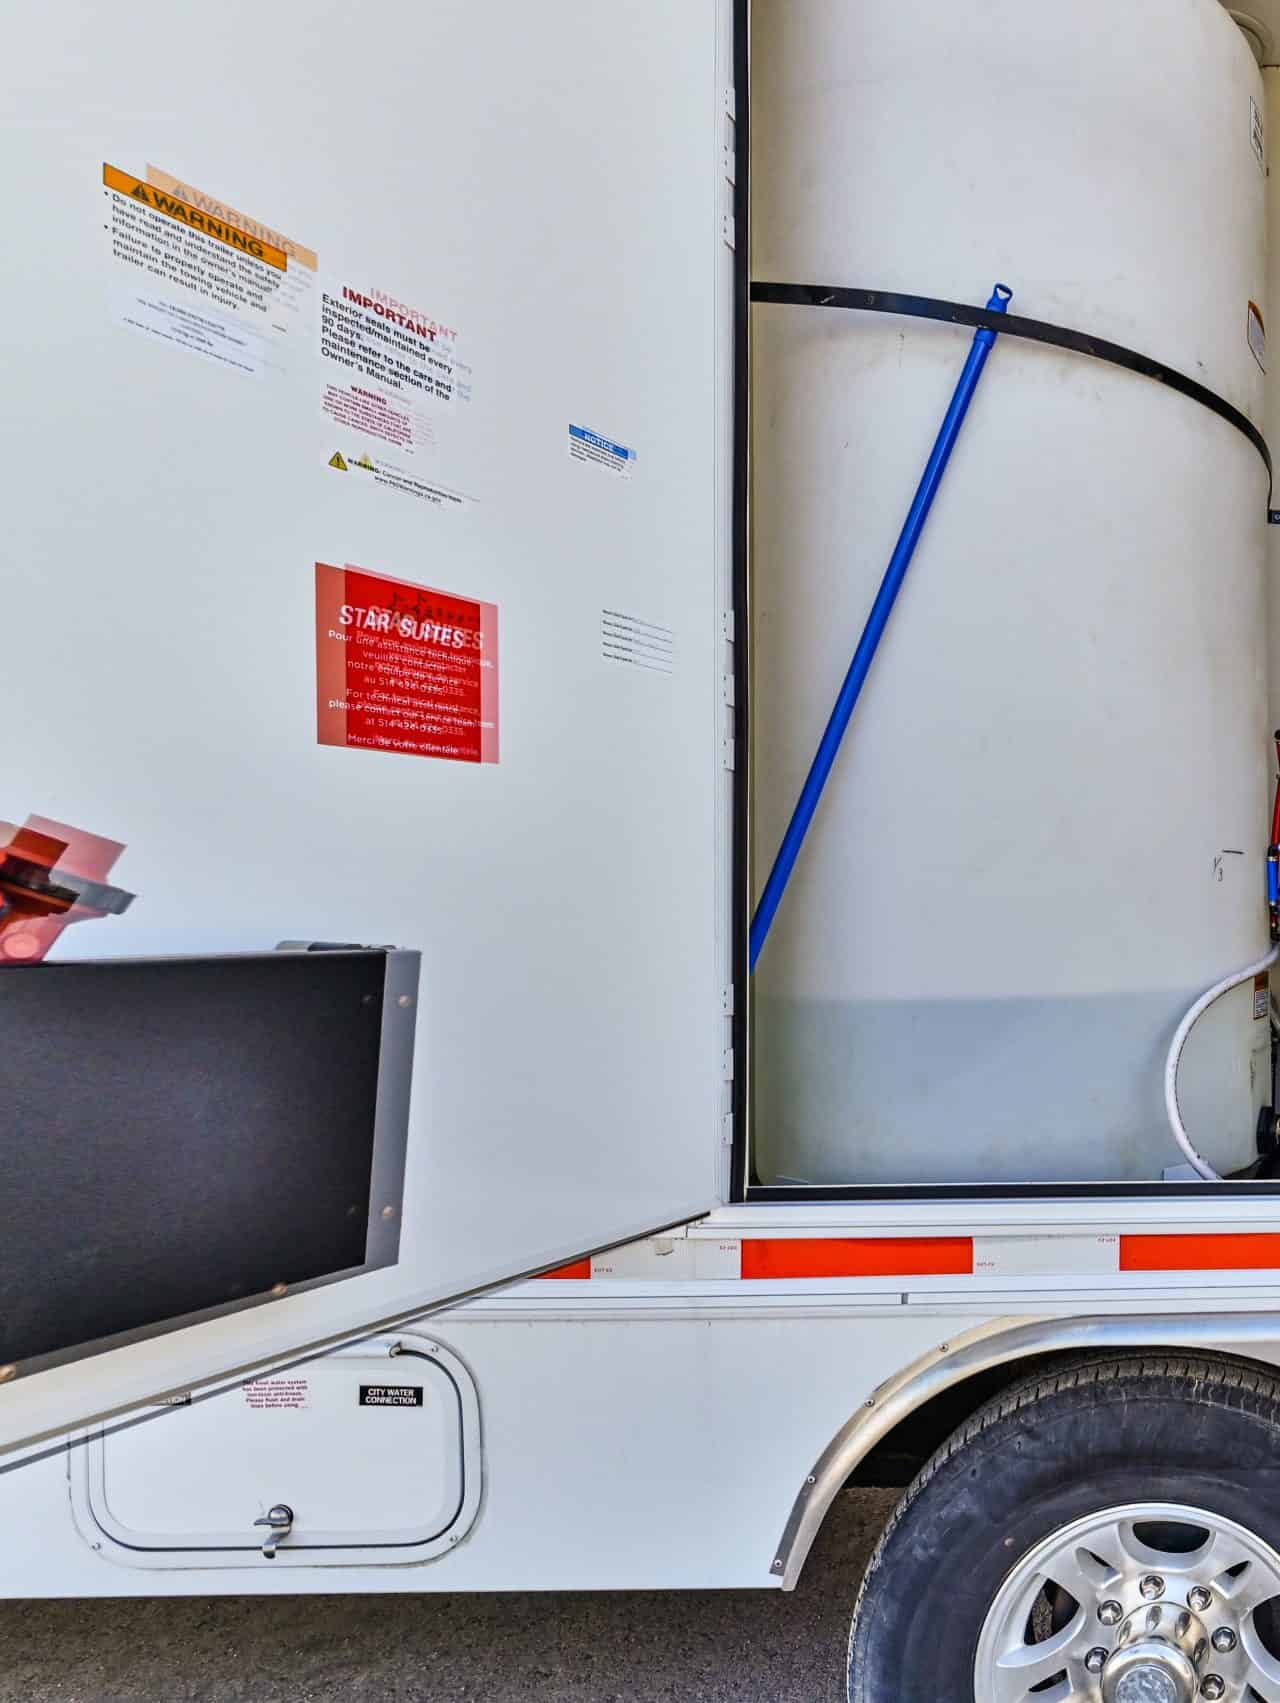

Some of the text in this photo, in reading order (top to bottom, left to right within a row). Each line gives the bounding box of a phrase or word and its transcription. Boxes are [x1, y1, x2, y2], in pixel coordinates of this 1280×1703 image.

[113, 194, 126, 205] Do
[130, 204, 145, 215] not
[149, 213, 186, 233] operate
[188, 230, 205, 243] this
[208, 240, 233, 256] trailer
[236, 255, 264, 271] unless
[113, 216, 169, 246] information
[172, 242, 181, 252] in
[183, 248, 198, 259] the
[113, 204, 280, 288] have read and understand the safety
[152, 191, 265, 258] WARNING
[112, 227, 262, 301] Failure to properly operate and
[113, 239, 266, 312] maintain the towing vehicle and
[113, 249, 240, 310] trailer can result in injury.
[322, 315, 334, 327] 90
[322, 294, 431, 352] Exterior seals must be
[322, 304, 452, 374] inspected/maintained every
[342, 286, 437, 342] IMPORTANT
[321, 347, 404, 390] Owner's Manual.
[321, 338, 450, 400] maintenance section of the
[322, 325, 452, 392] Please refer to the care and
[351, 385, 387, 405] WARNING
[328, 630, 352, 642] Pour
[339, 604, 465, 649] STAR SUITES
[328, 699, 361, 712] please
[346, 688, 363, 698] For
[347, 733, 375, 745] Merci
[365, 1396, 417, 1405] CONNECTION
[368, 1387, 415, 1397] CITY WATER
